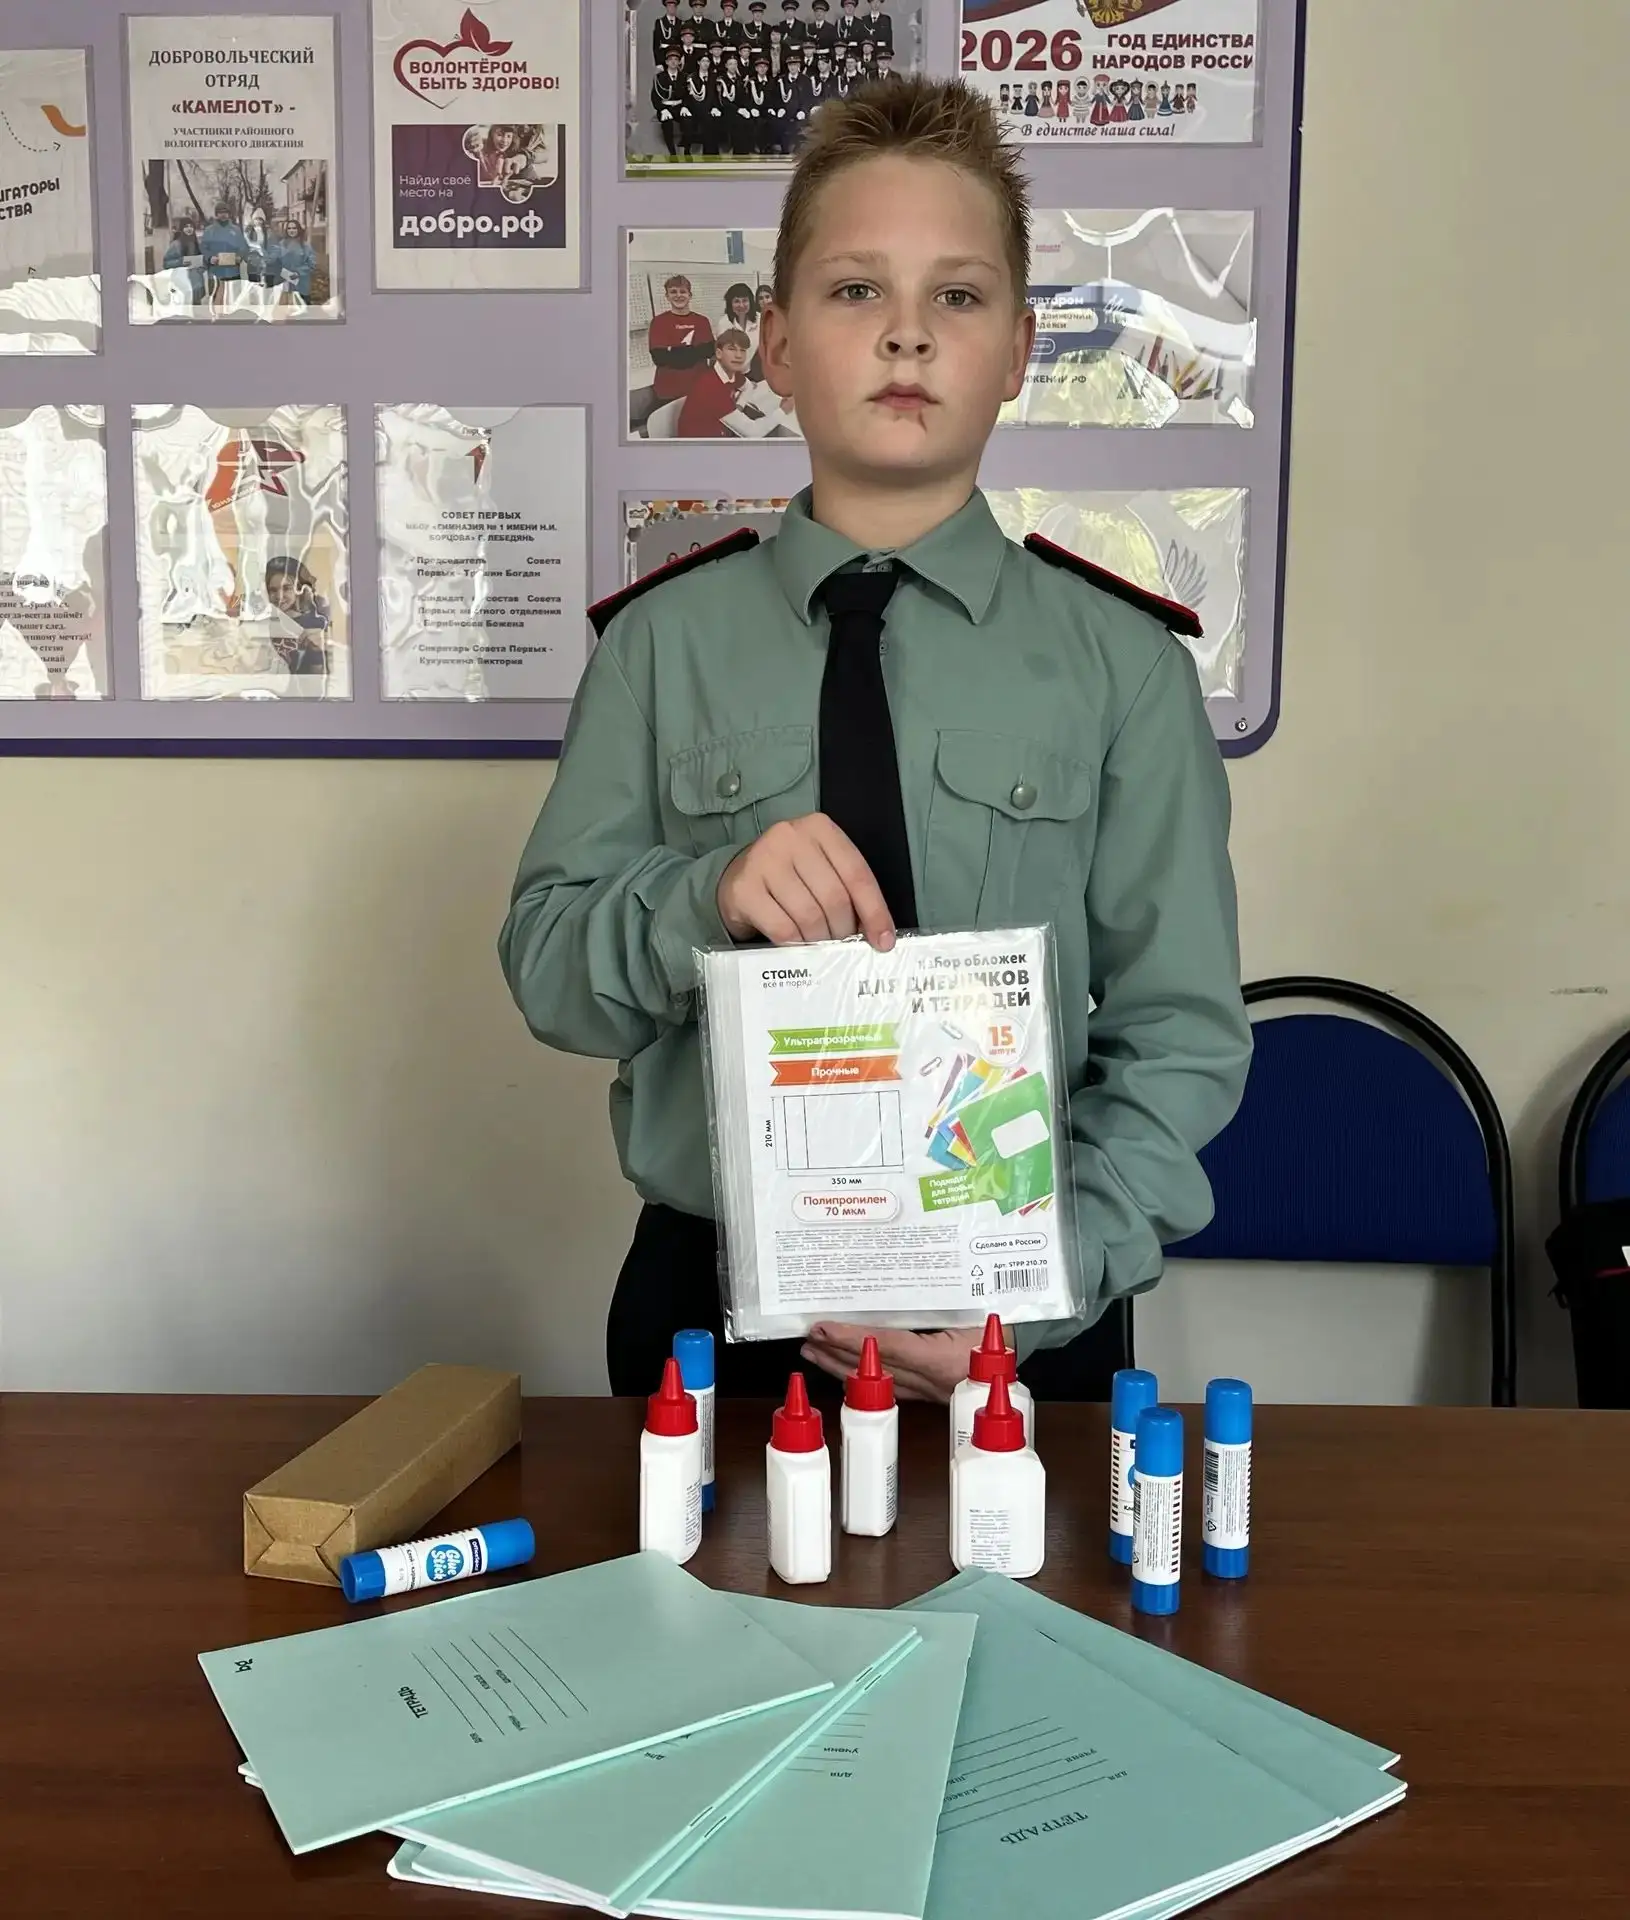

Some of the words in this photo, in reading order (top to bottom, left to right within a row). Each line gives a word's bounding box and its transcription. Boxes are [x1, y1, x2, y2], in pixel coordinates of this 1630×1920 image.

[1107, 34, 1147, 50] ГОД
[1151, 33, 1253, 49] ЕДИНСТВА
[149, 47, 314, 67] ДОБРОВОЛЬЧЕСКИЙ
[961, 29, 1082, 71] 2026
[409, 58, 527, 74] ВОЛОНТЁРОМ
[1092, 54, 1186, 71] НАРОДОВ
[205, 74, 260, 90] ОТРЯД
[419, 77, 467, 90] БЫТЬ
[472, 77, 560, 92] ЗДОРОВО!
[172, 100, 284, 115] «КАМЕЛОТ»
[173, 127, 231, 136] УЧАСТНИКИ
[232, 126, 295, 136] РАЙОННОГО
[1020, 125, 1033, 136] В
[1036, 126, 1097, 137] единстве
[1100, 126, 1136, 136] наша
[1139, 124, 1175, 137] сила!
[164, 139, 248, 149] ВОЛОНТЕРСКОГО
[249, 139, 304, 149] ДВИЖЕНИЯ
[400, 175, 439, 188] Найди
[400, 189, 435, 198] место
[438, 189, 453, 197] на
[399, 209, 544, 238] добро.рф
[441, 511, 475, 519] СОВЕТ
[477, 511, 521, 519] ПЕРВЫХ
[487, 534, 535, 543] ЛЕБЕДЯНЬ
[526, 556, 561, 565] Совета
[463, 569, 502, 578] Тршин
[505, 569, 541, 577] Богдан
[527, 595, 562, 603] Совета
[509, 608, 562, 616] отделения
[485, 619, 524, 628] Божена
[472, 644, 506, 652] Совета
[509, 645, 547, 653] Первых
[964, 953, 1027, 968] обложек
[857, 978, 900, 998] ДЛЯ
[911, 997, 925, 1014] И
[929, 987, 1031, 1014] ТЕТРАДЕЙ
[988, 1025, 1014, 1047] 15
[811, 1065, 860, 1079] Прочные
[831, 1177, 847, 1186] 350
[848, 1177, 862, 1185] мм
[803, 1195, 887, 1208] Полипропилен
[825, 1206, 840, 1217] 70
[842, 1208, 867, 1217] мкм
[430, 1550, 444, 1581] Stick
[446, 1550, 458, 1576] Glue
[397, 1685, 428, 1719] ТЕТРАДЬ
[1000, 1811, 1089, 1845] ТЕТРАДЬ
